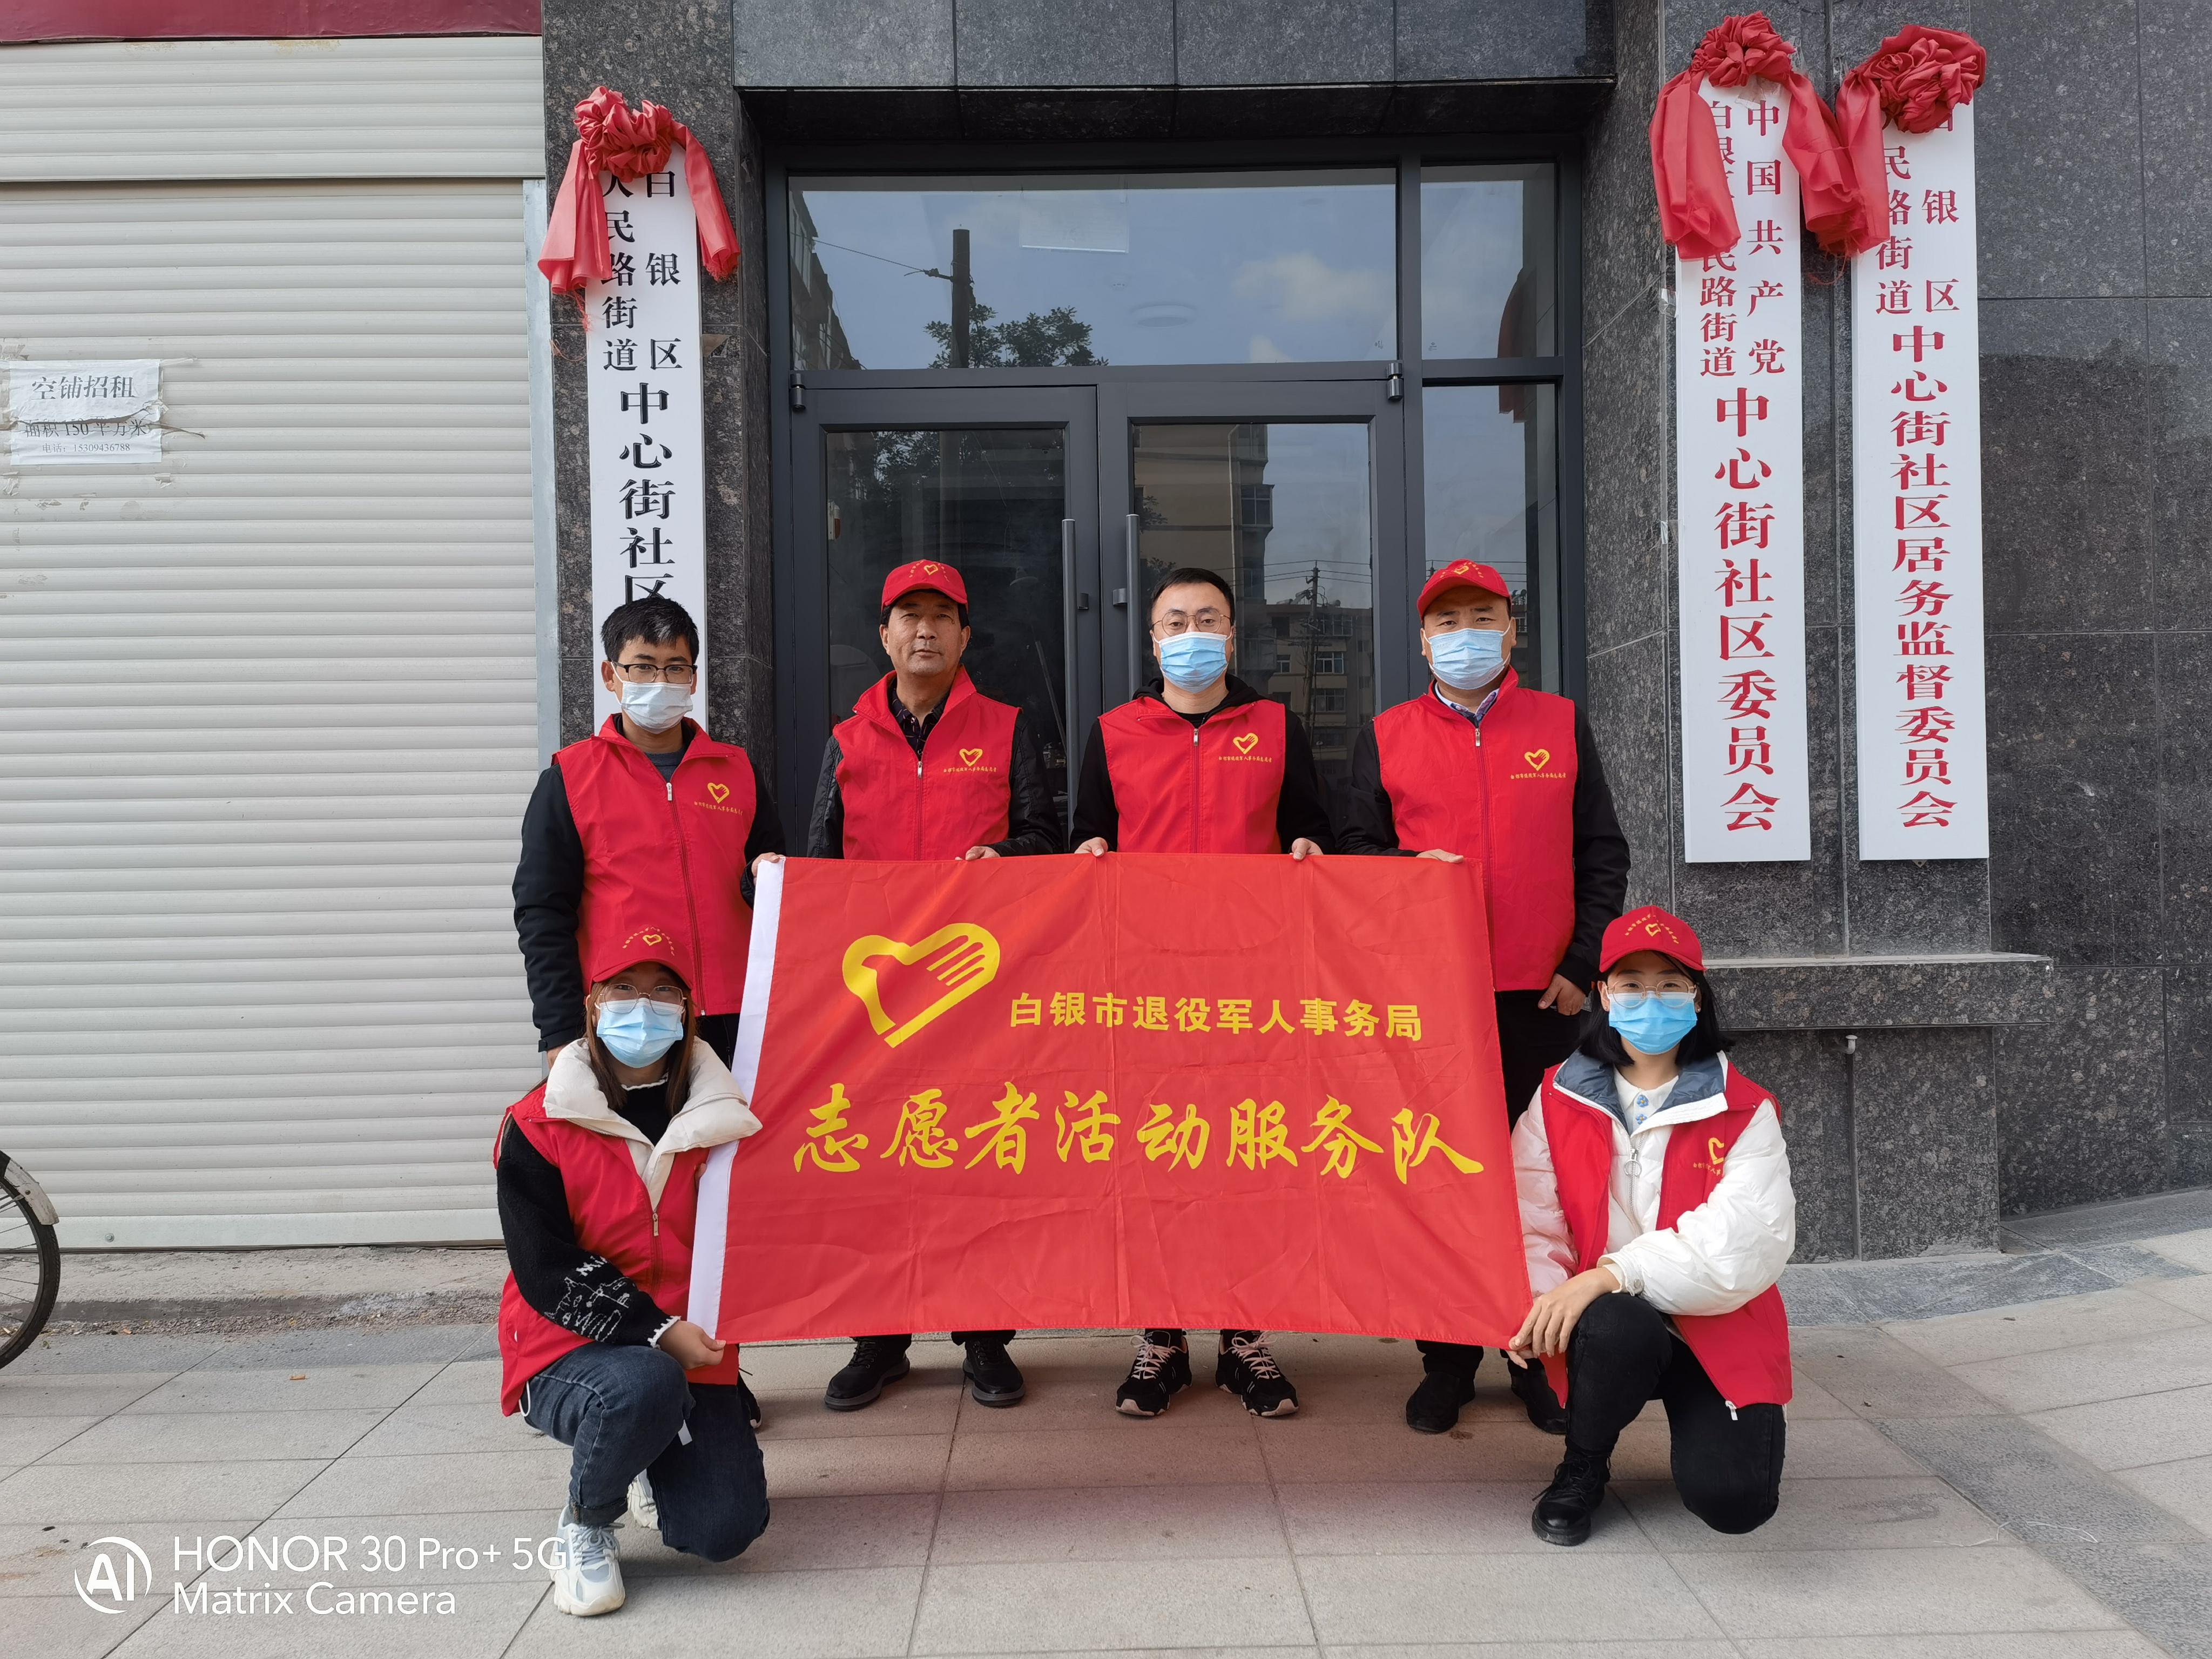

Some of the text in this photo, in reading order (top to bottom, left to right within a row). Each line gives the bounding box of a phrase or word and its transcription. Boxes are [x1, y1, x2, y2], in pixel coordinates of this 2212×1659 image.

[645, 171, 683, 371] 白银区
[1746, 100, 1785, 375] 中国共产党
[31, 375, 136, 400] 空铺招租
[1714, 387, 1781, 831] 中心街社区委员会
[1890, 325, 1958, 828] 中心街社区居务监督委员会
[1009, 992, 1422, 1042] 白银市退役军人事务局
[794, 1082, 1485, 1185] 志愿者活动服务队
